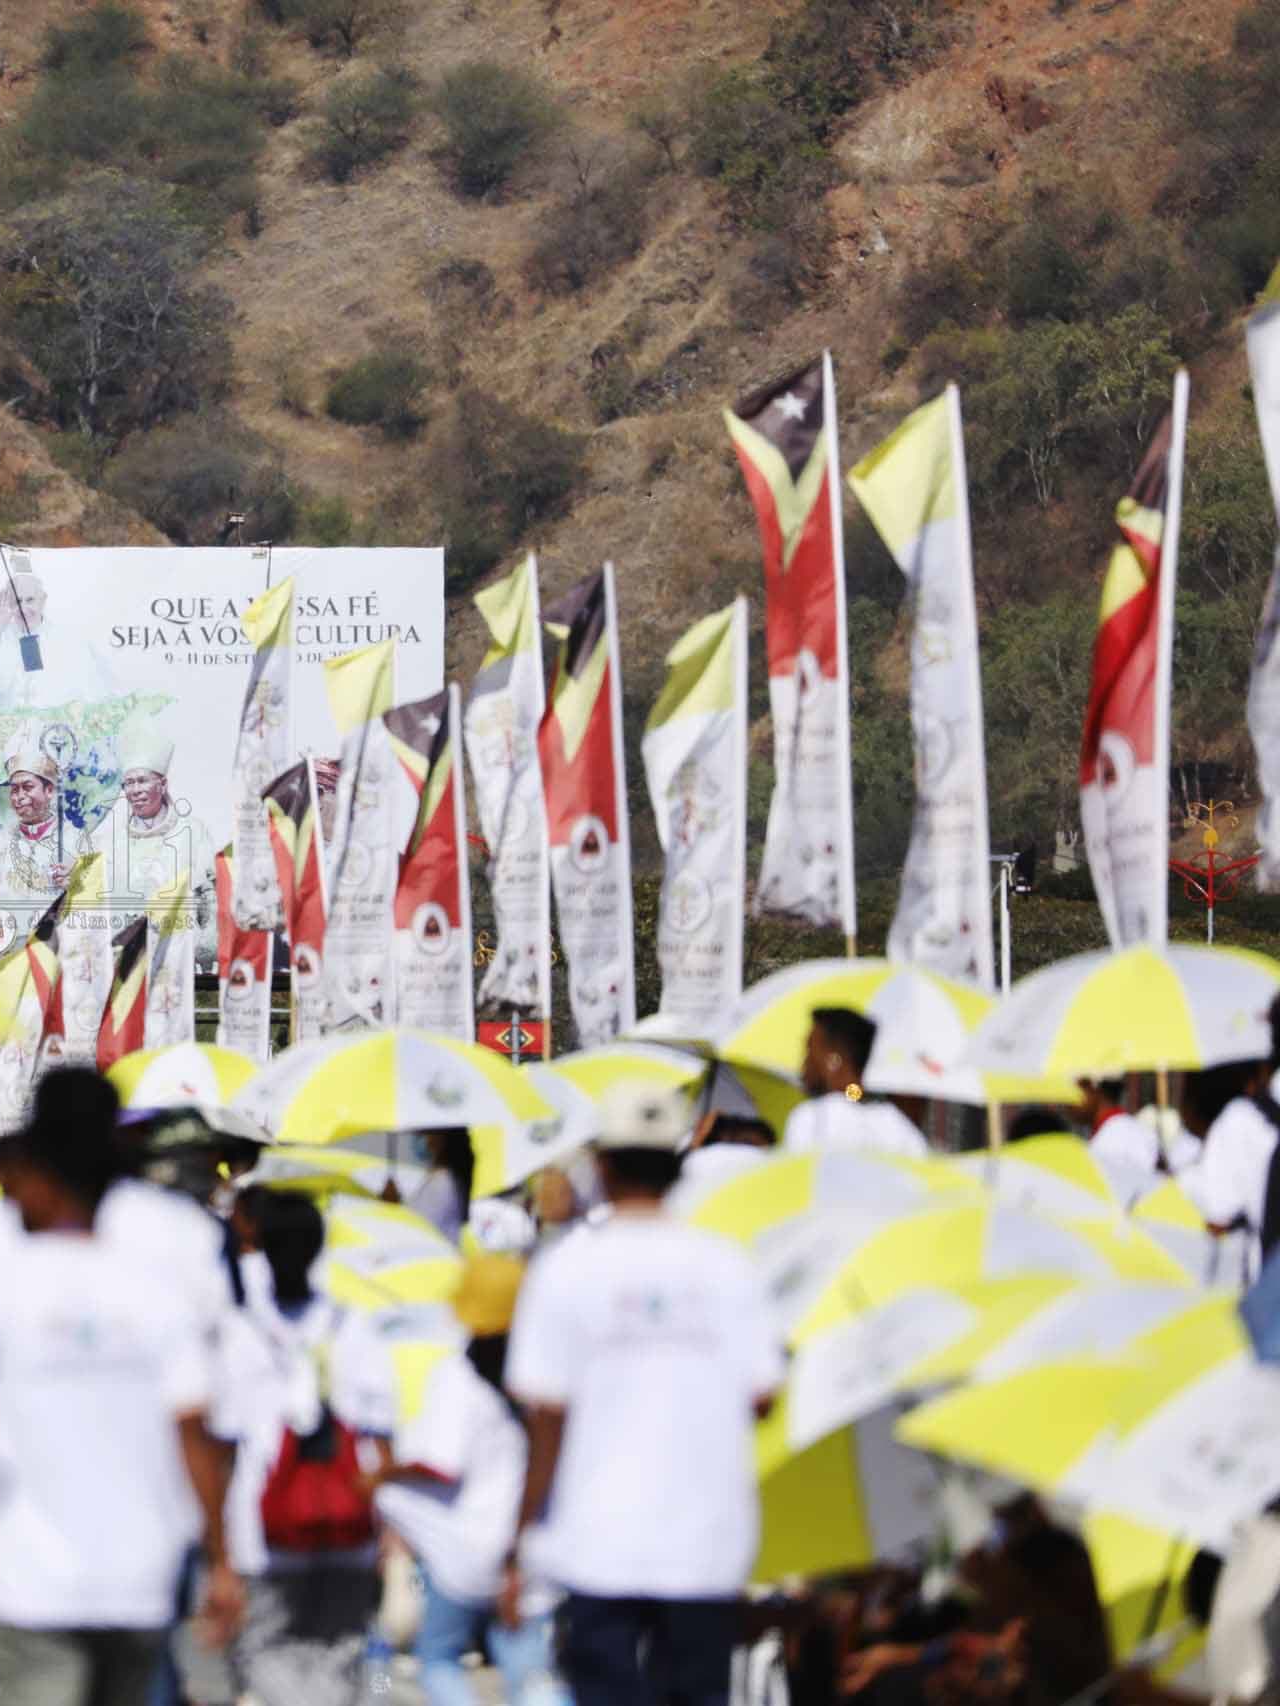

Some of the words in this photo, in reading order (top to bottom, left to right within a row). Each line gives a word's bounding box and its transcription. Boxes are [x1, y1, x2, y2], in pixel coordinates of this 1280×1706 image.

[151, 597, 214, 625] QUE
[222, 598, 240, 618] A
[349, 592, 380, 617] FÉ
[111, 624, 169, 649] SEJA
[175, 626, 192, 645] A
[295, 624, 422, 646] CULTURA
